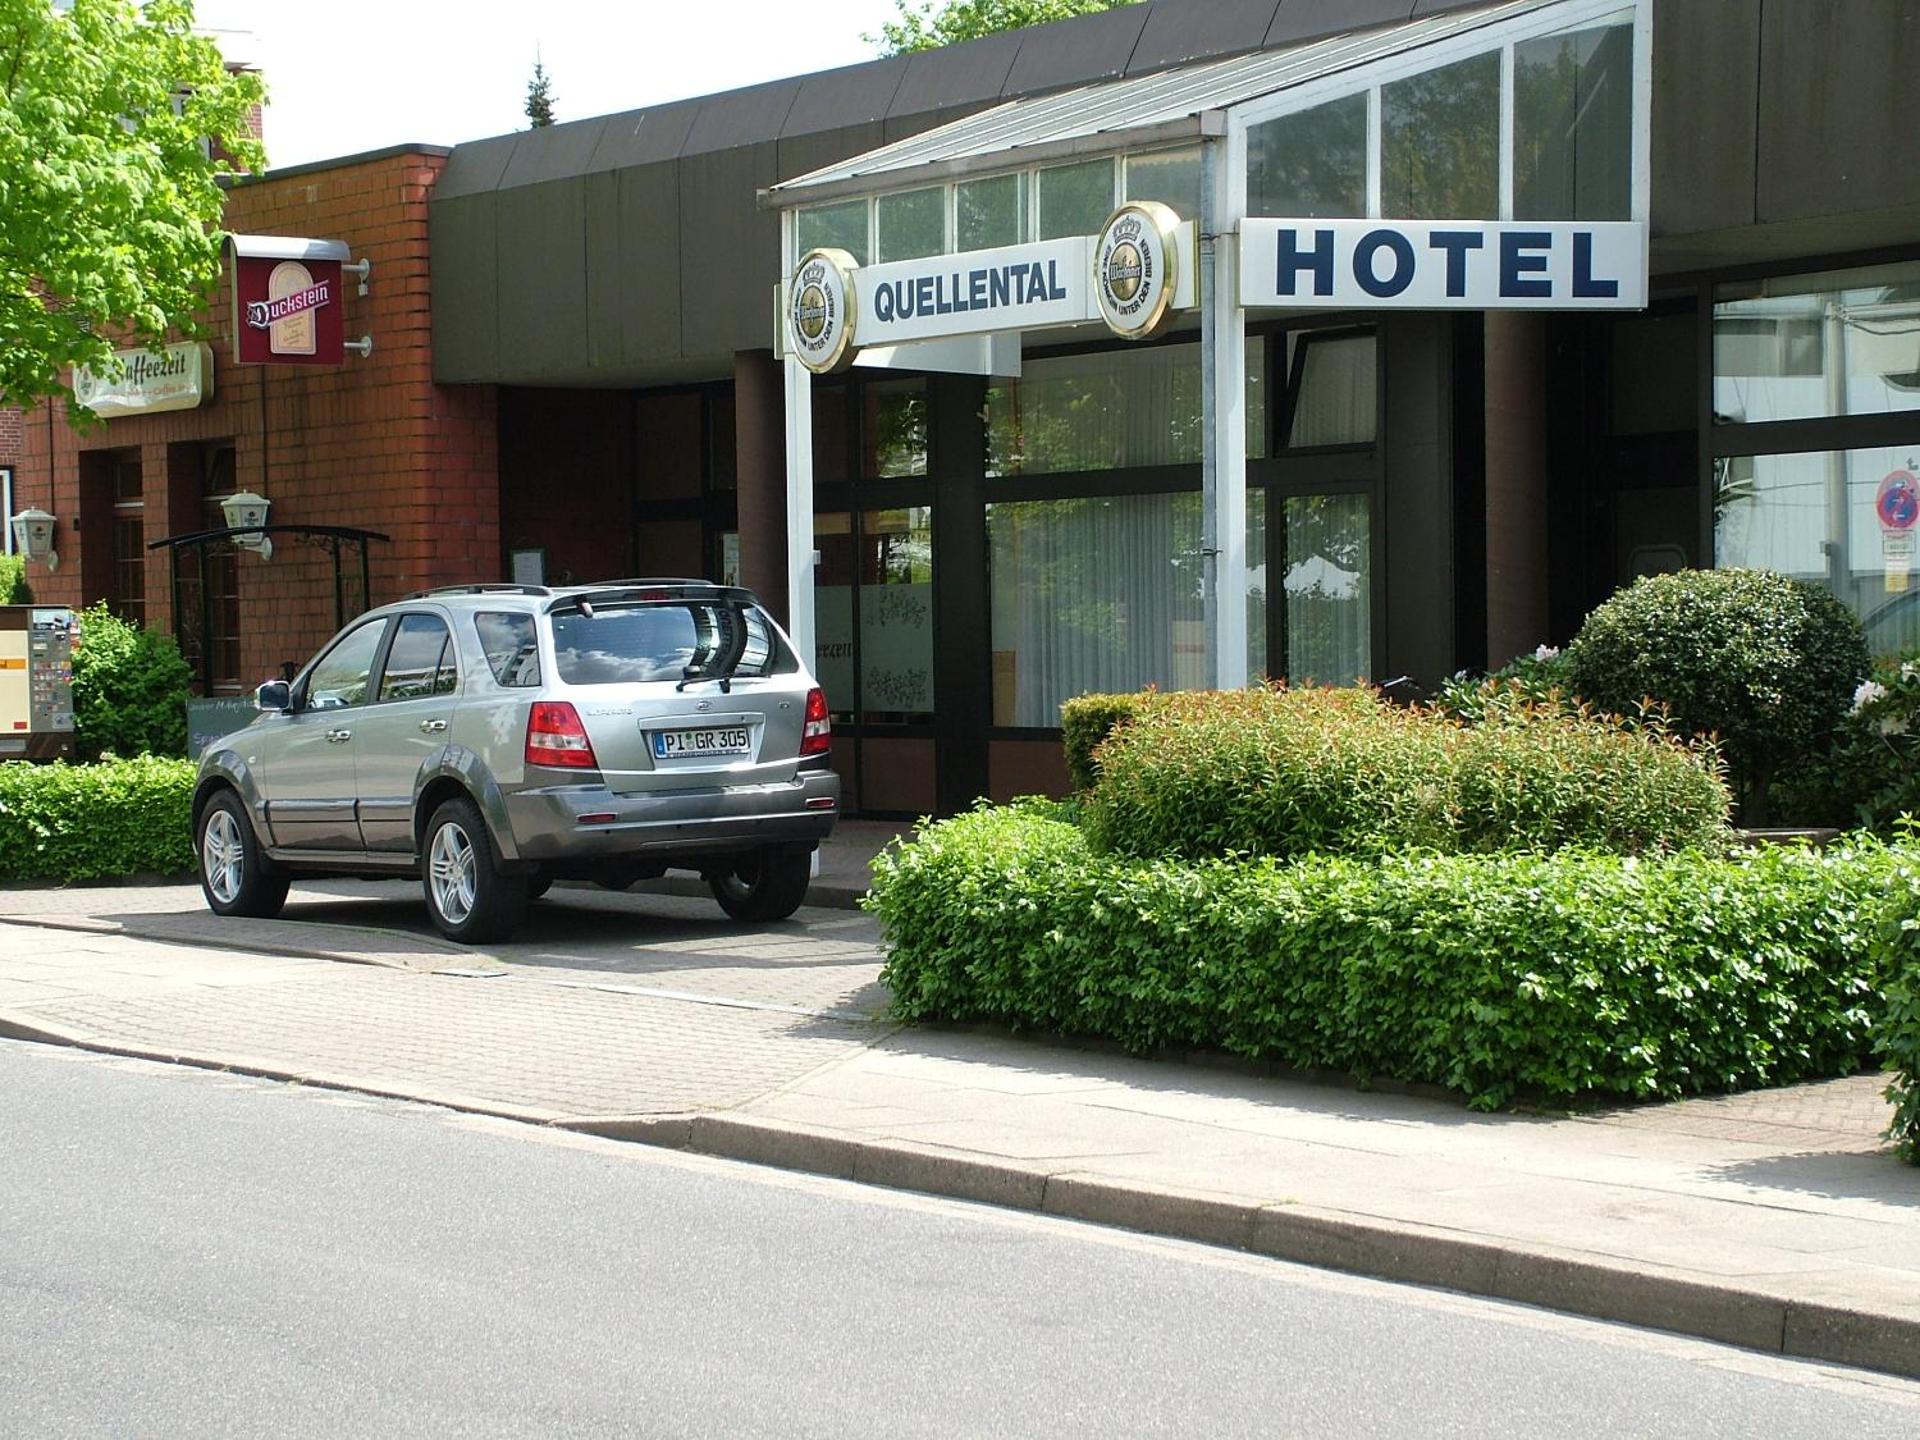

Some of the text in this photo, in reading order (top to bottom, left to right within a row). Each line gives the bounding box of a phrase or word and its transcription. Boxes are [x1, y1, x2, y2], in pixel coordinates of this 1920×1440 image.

[1277, 229, 1619, 298] HOTEL
[246, 286, 328, 329] Duckstein
[874, 259, 1066, 323] QUELLENTAL
[1119, 300, 1141, 316] UNTER
[1138, 281, 1151, 304] DEN
[665, 734, 685, 751] PI
[694, 732, 717, 749] GR
[719, 729, 748, 748] 305
